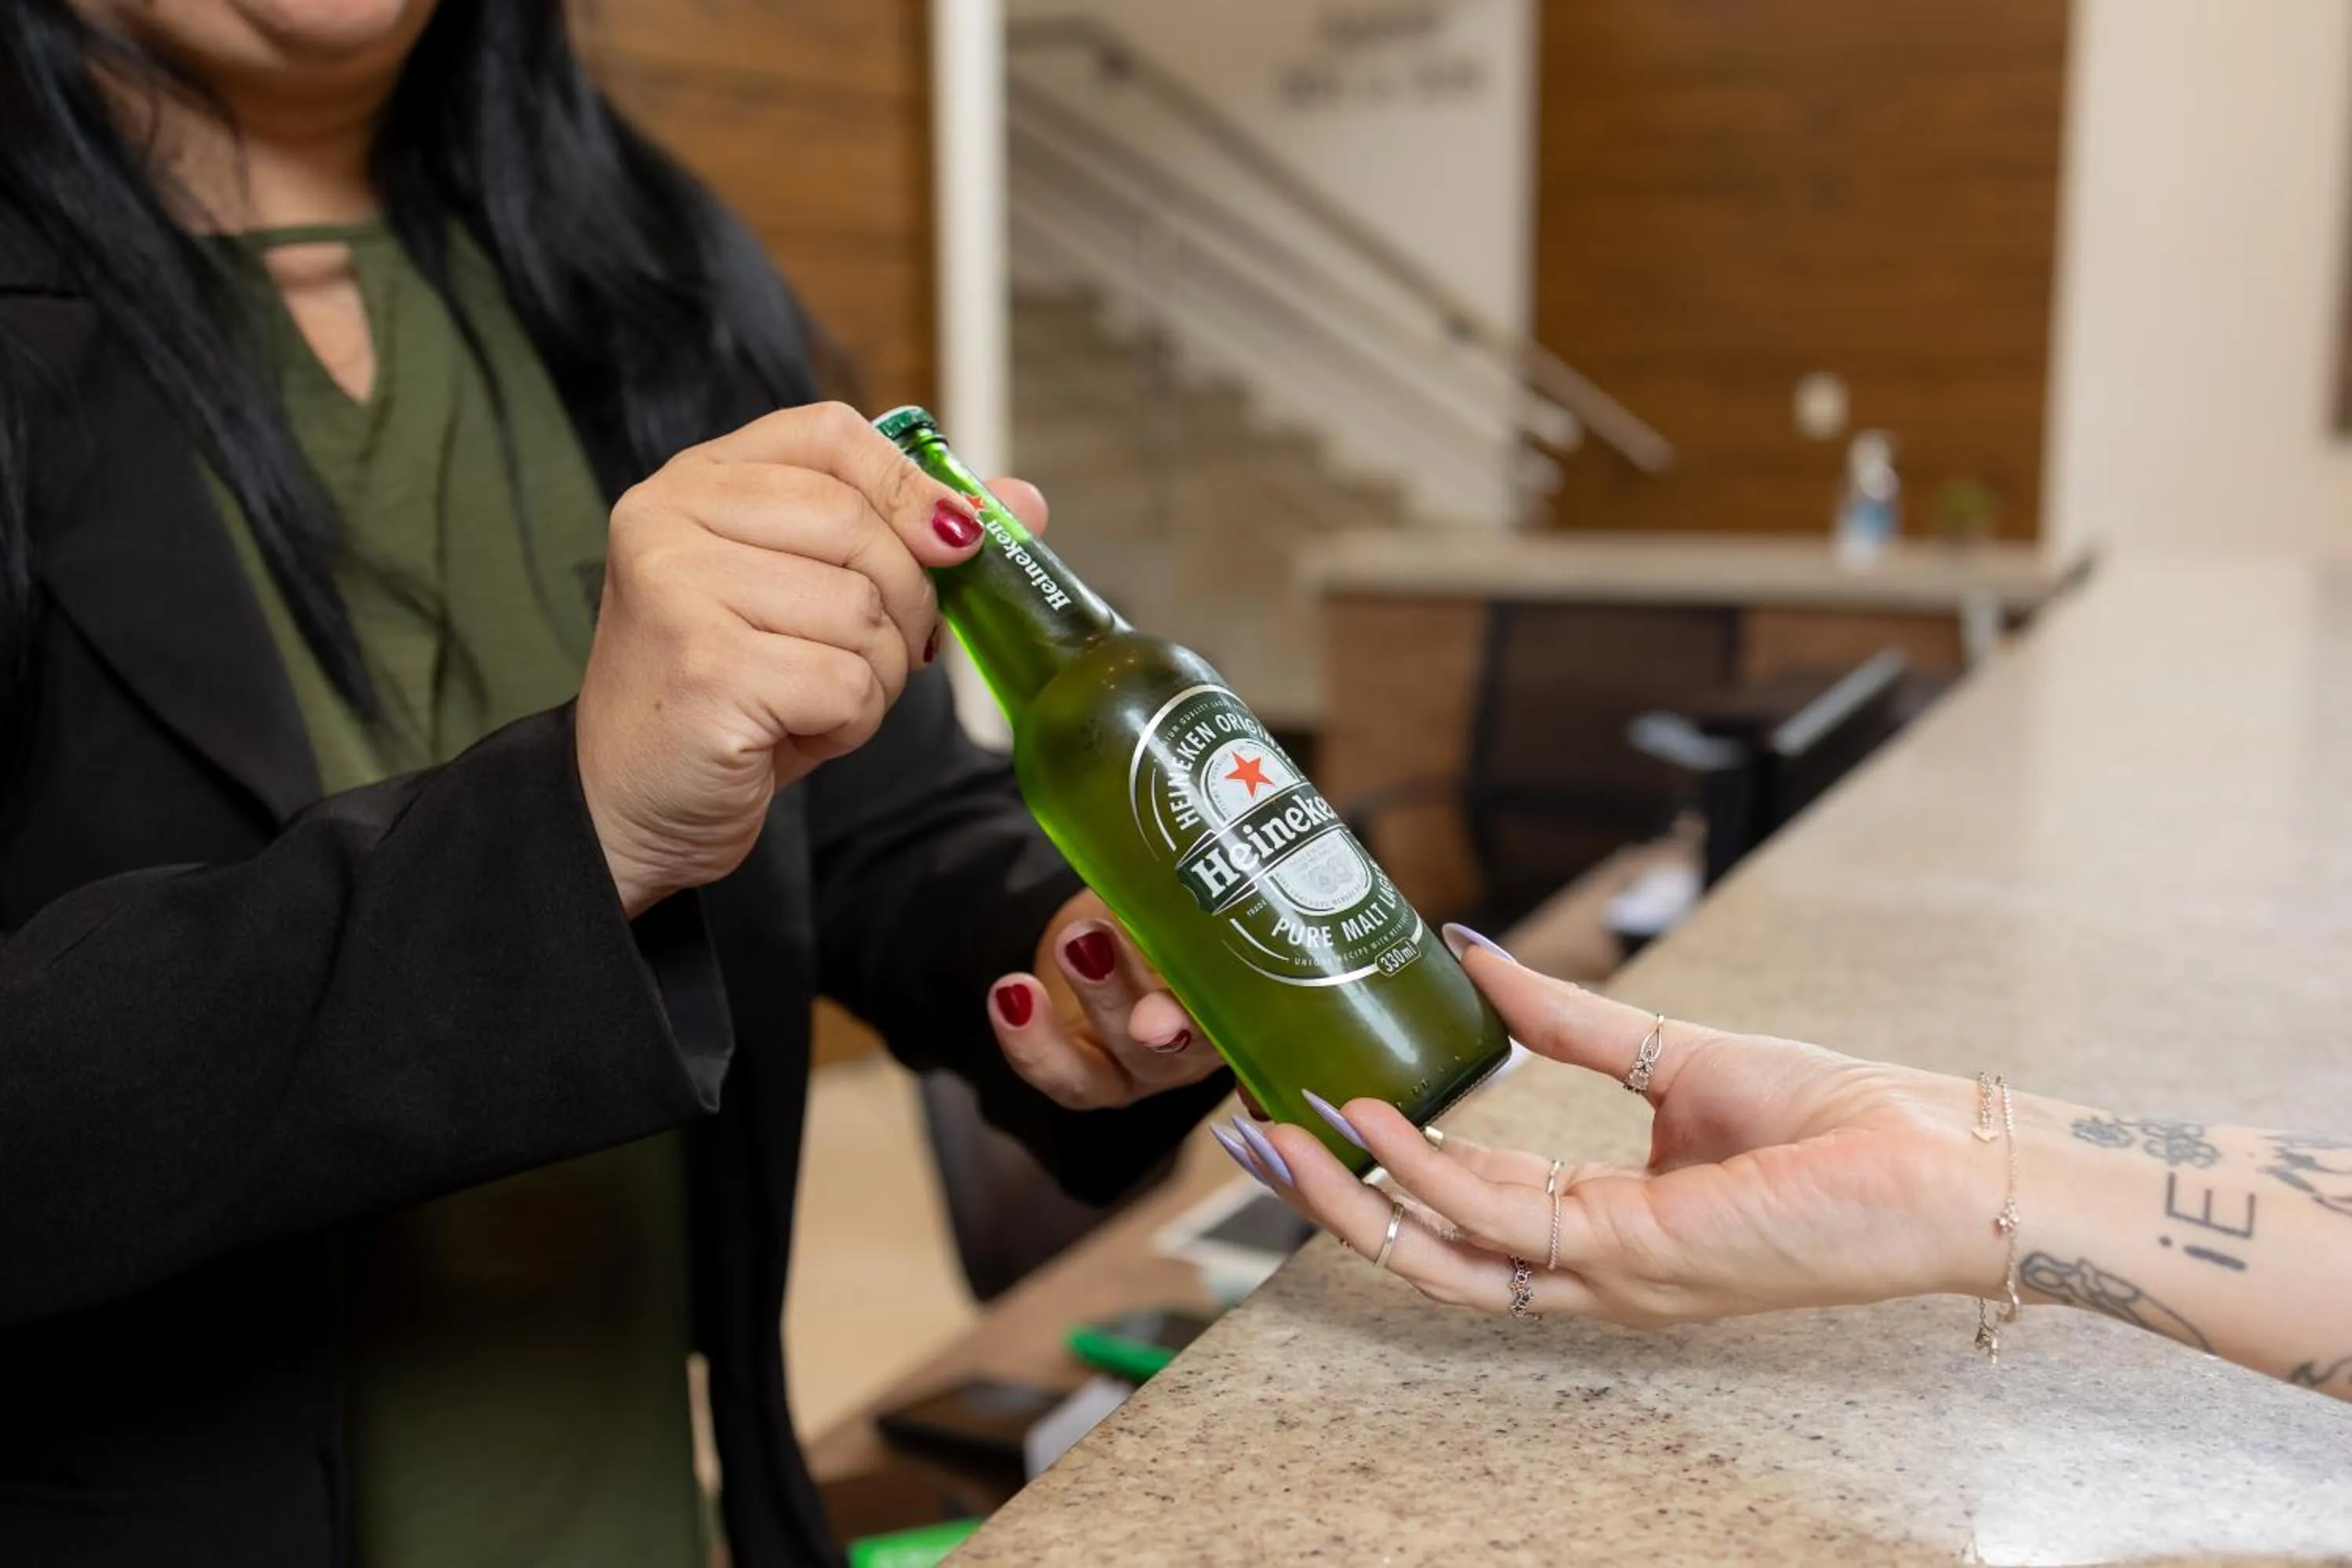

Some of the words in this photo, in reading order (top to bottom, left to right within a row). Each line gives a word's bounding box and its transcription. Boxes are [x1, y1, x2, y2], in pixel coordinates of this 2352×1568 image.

[985, 519, 1072, 612] Heineken
[1167, 720, 1218, 831] HEINEKEN
[1189, 790, 1338, 899] Heineke
[1271, 916, 1334, 948] PURE
[1340, 902, 1389, 942] MALT
[1380, 939, 1418, 973] 330ml
